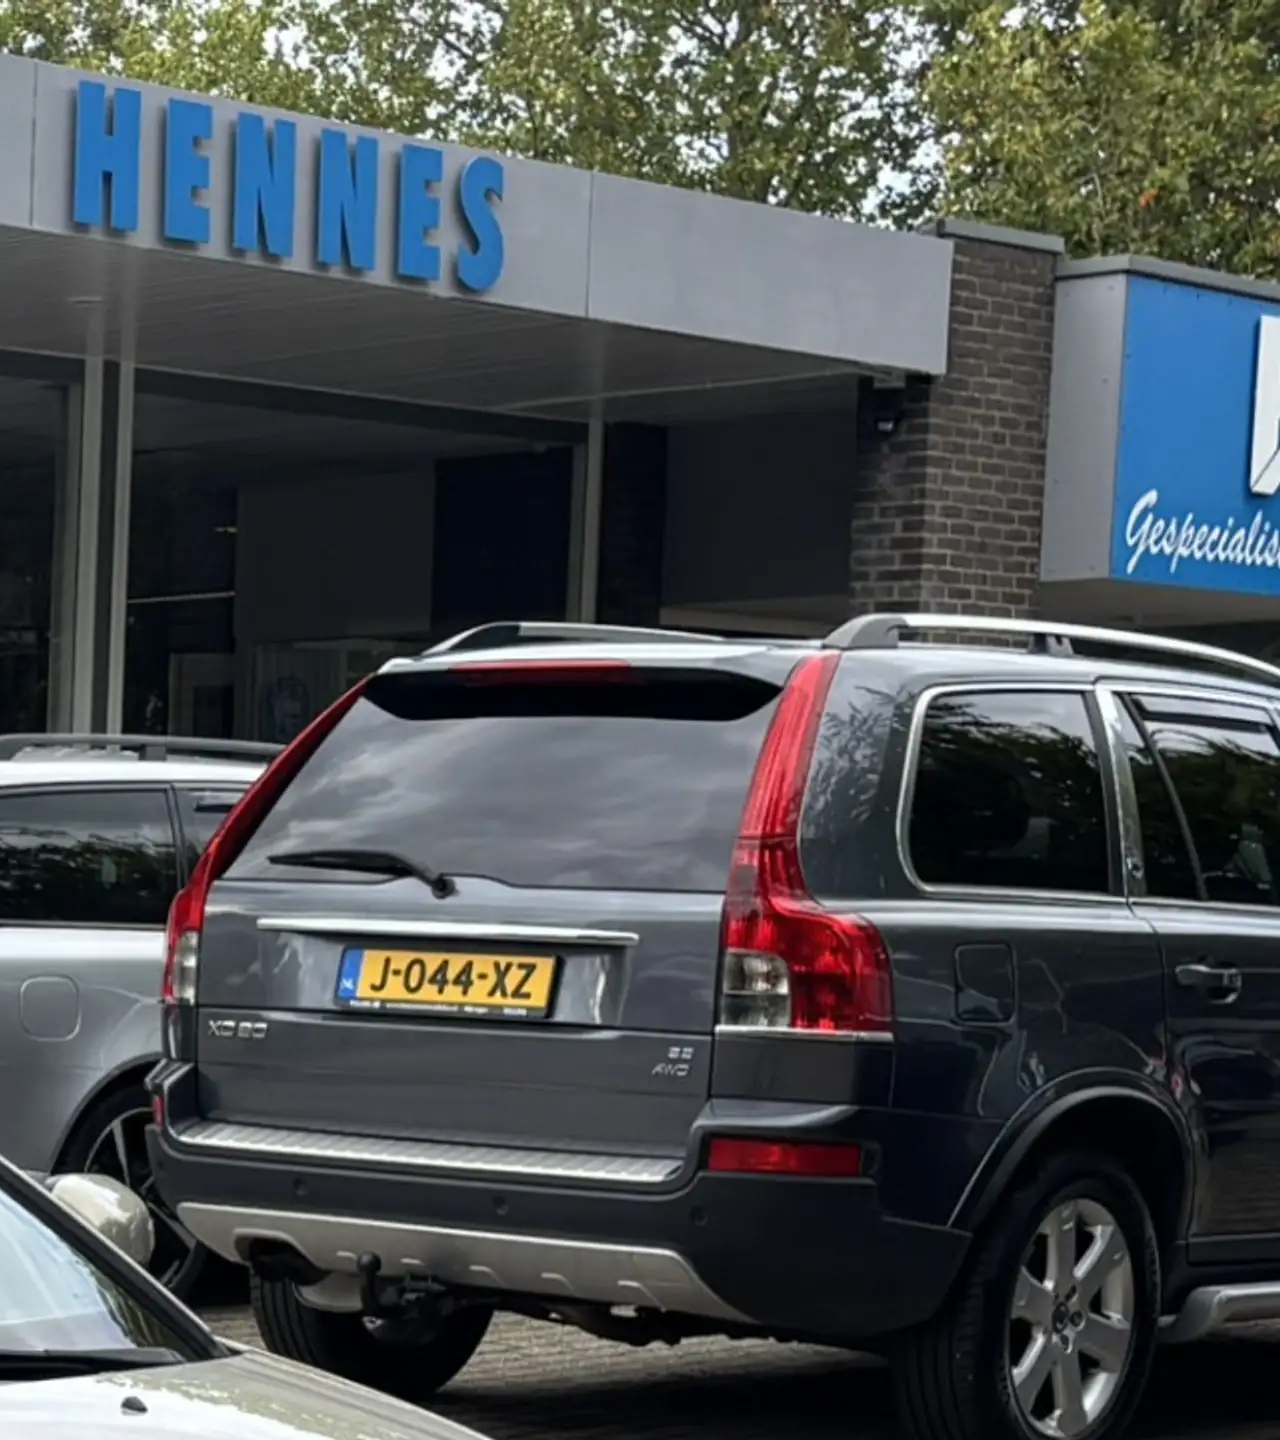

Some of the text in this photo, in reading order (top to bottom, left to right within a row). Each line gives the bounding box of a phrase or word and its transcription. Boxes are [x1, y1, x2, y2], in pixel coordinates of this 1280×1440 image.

[73, 80, 505, 293] HENNES
[1125, 488, 1280, 576] Gespecialis
[368, 955, 538, 1000] J-044-XZ
